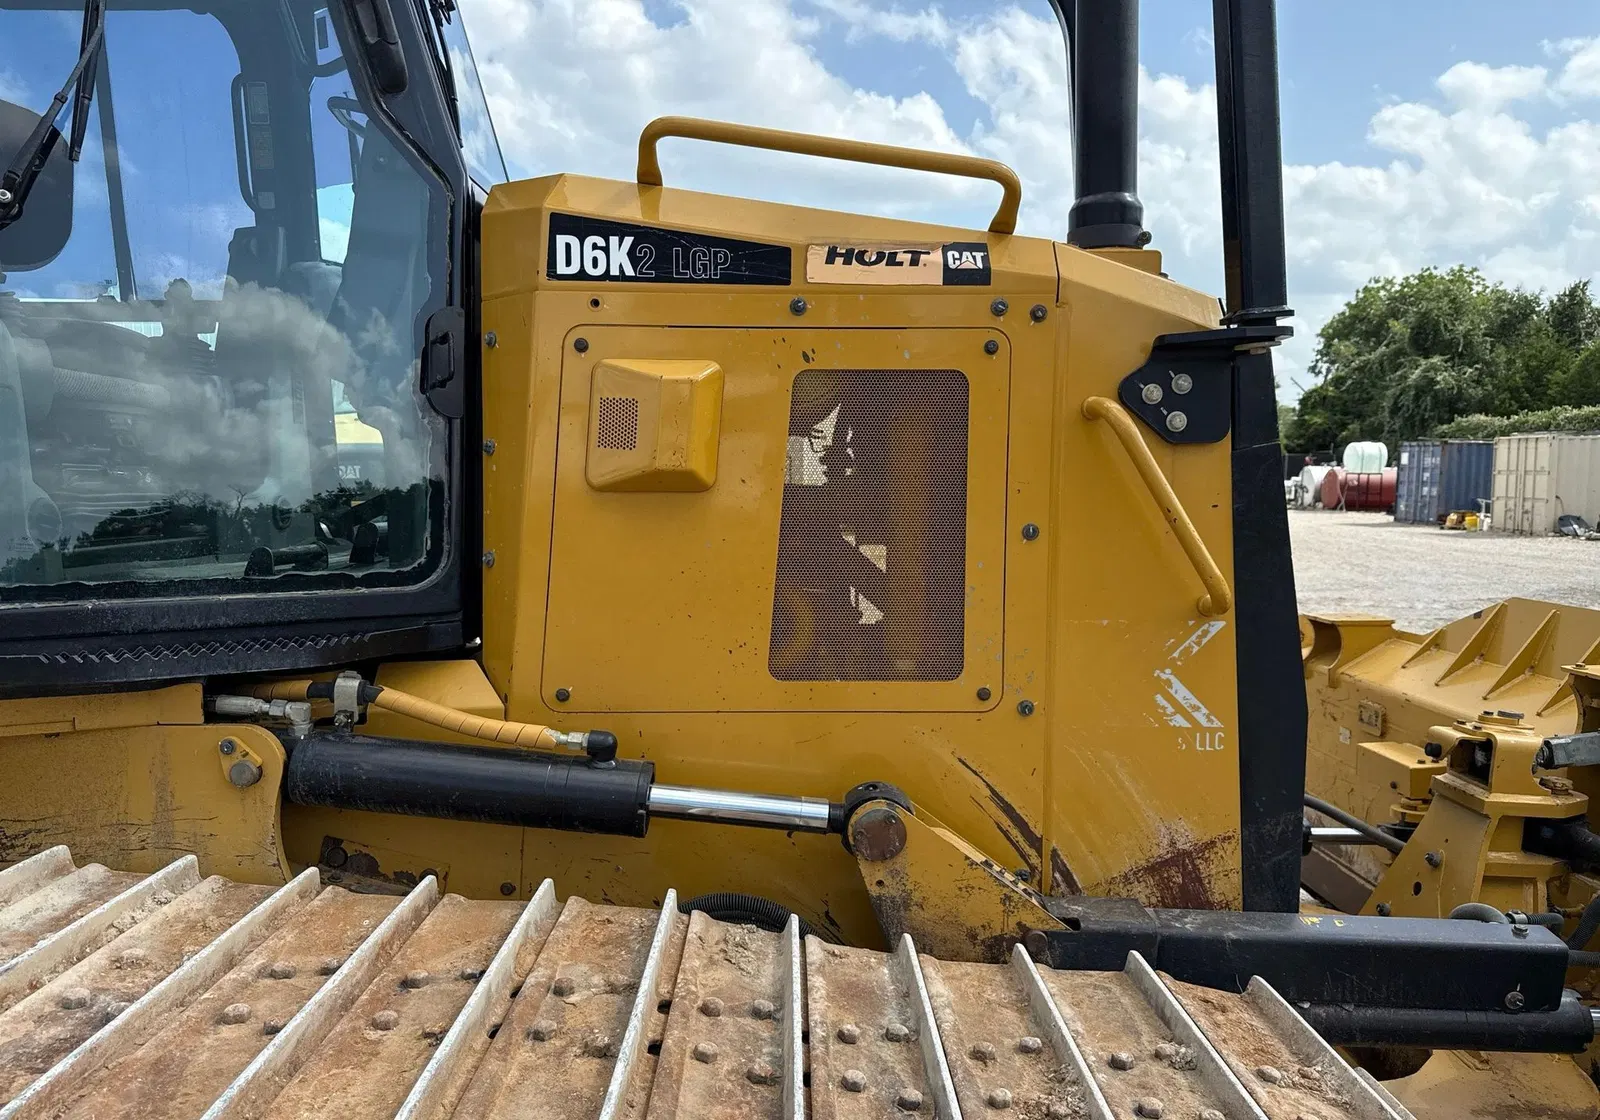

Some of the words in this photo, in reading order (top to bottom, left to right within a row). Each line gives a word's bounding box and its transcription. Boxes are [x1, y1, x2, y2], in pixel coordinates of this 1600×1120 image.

[672, 247, 731, 279] LGP
[824, 245, 931, 267] HOLT
[946, 250, 985, 270] CAT
[1196, 731, 1225, 751] LLC
